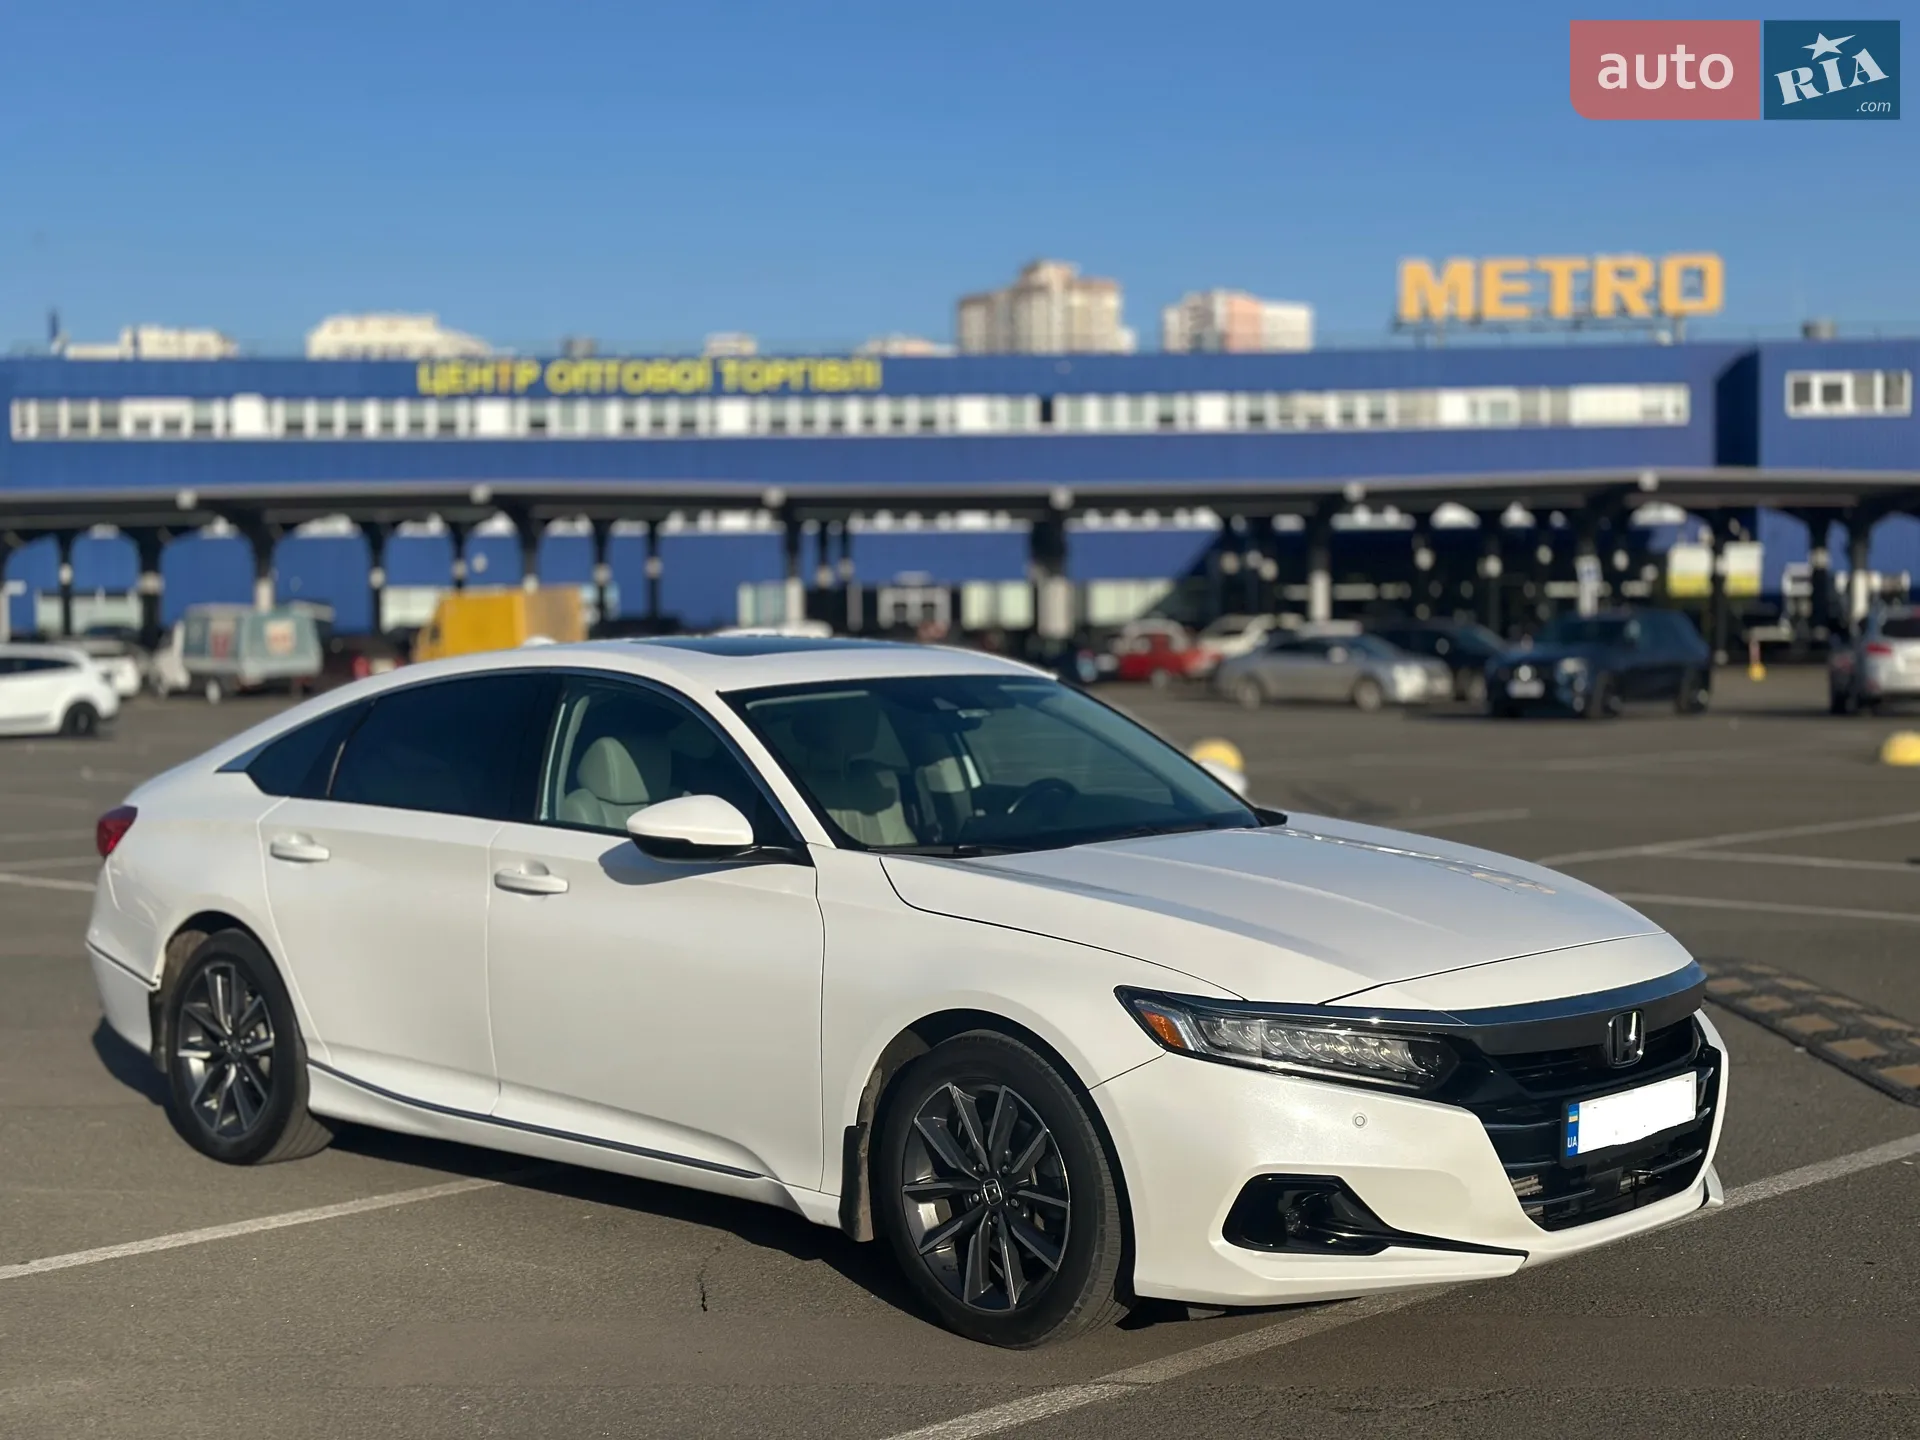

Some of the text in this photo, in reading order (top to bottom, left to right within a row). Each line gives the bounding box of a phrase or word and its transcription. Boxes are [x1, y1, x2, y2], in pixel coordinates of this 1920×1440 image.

[1400, 253, 1723, 322] METRO
[416, 359, 541, 395] ЦЕНТР
[1567, 1136, 1578, 1148] UA
